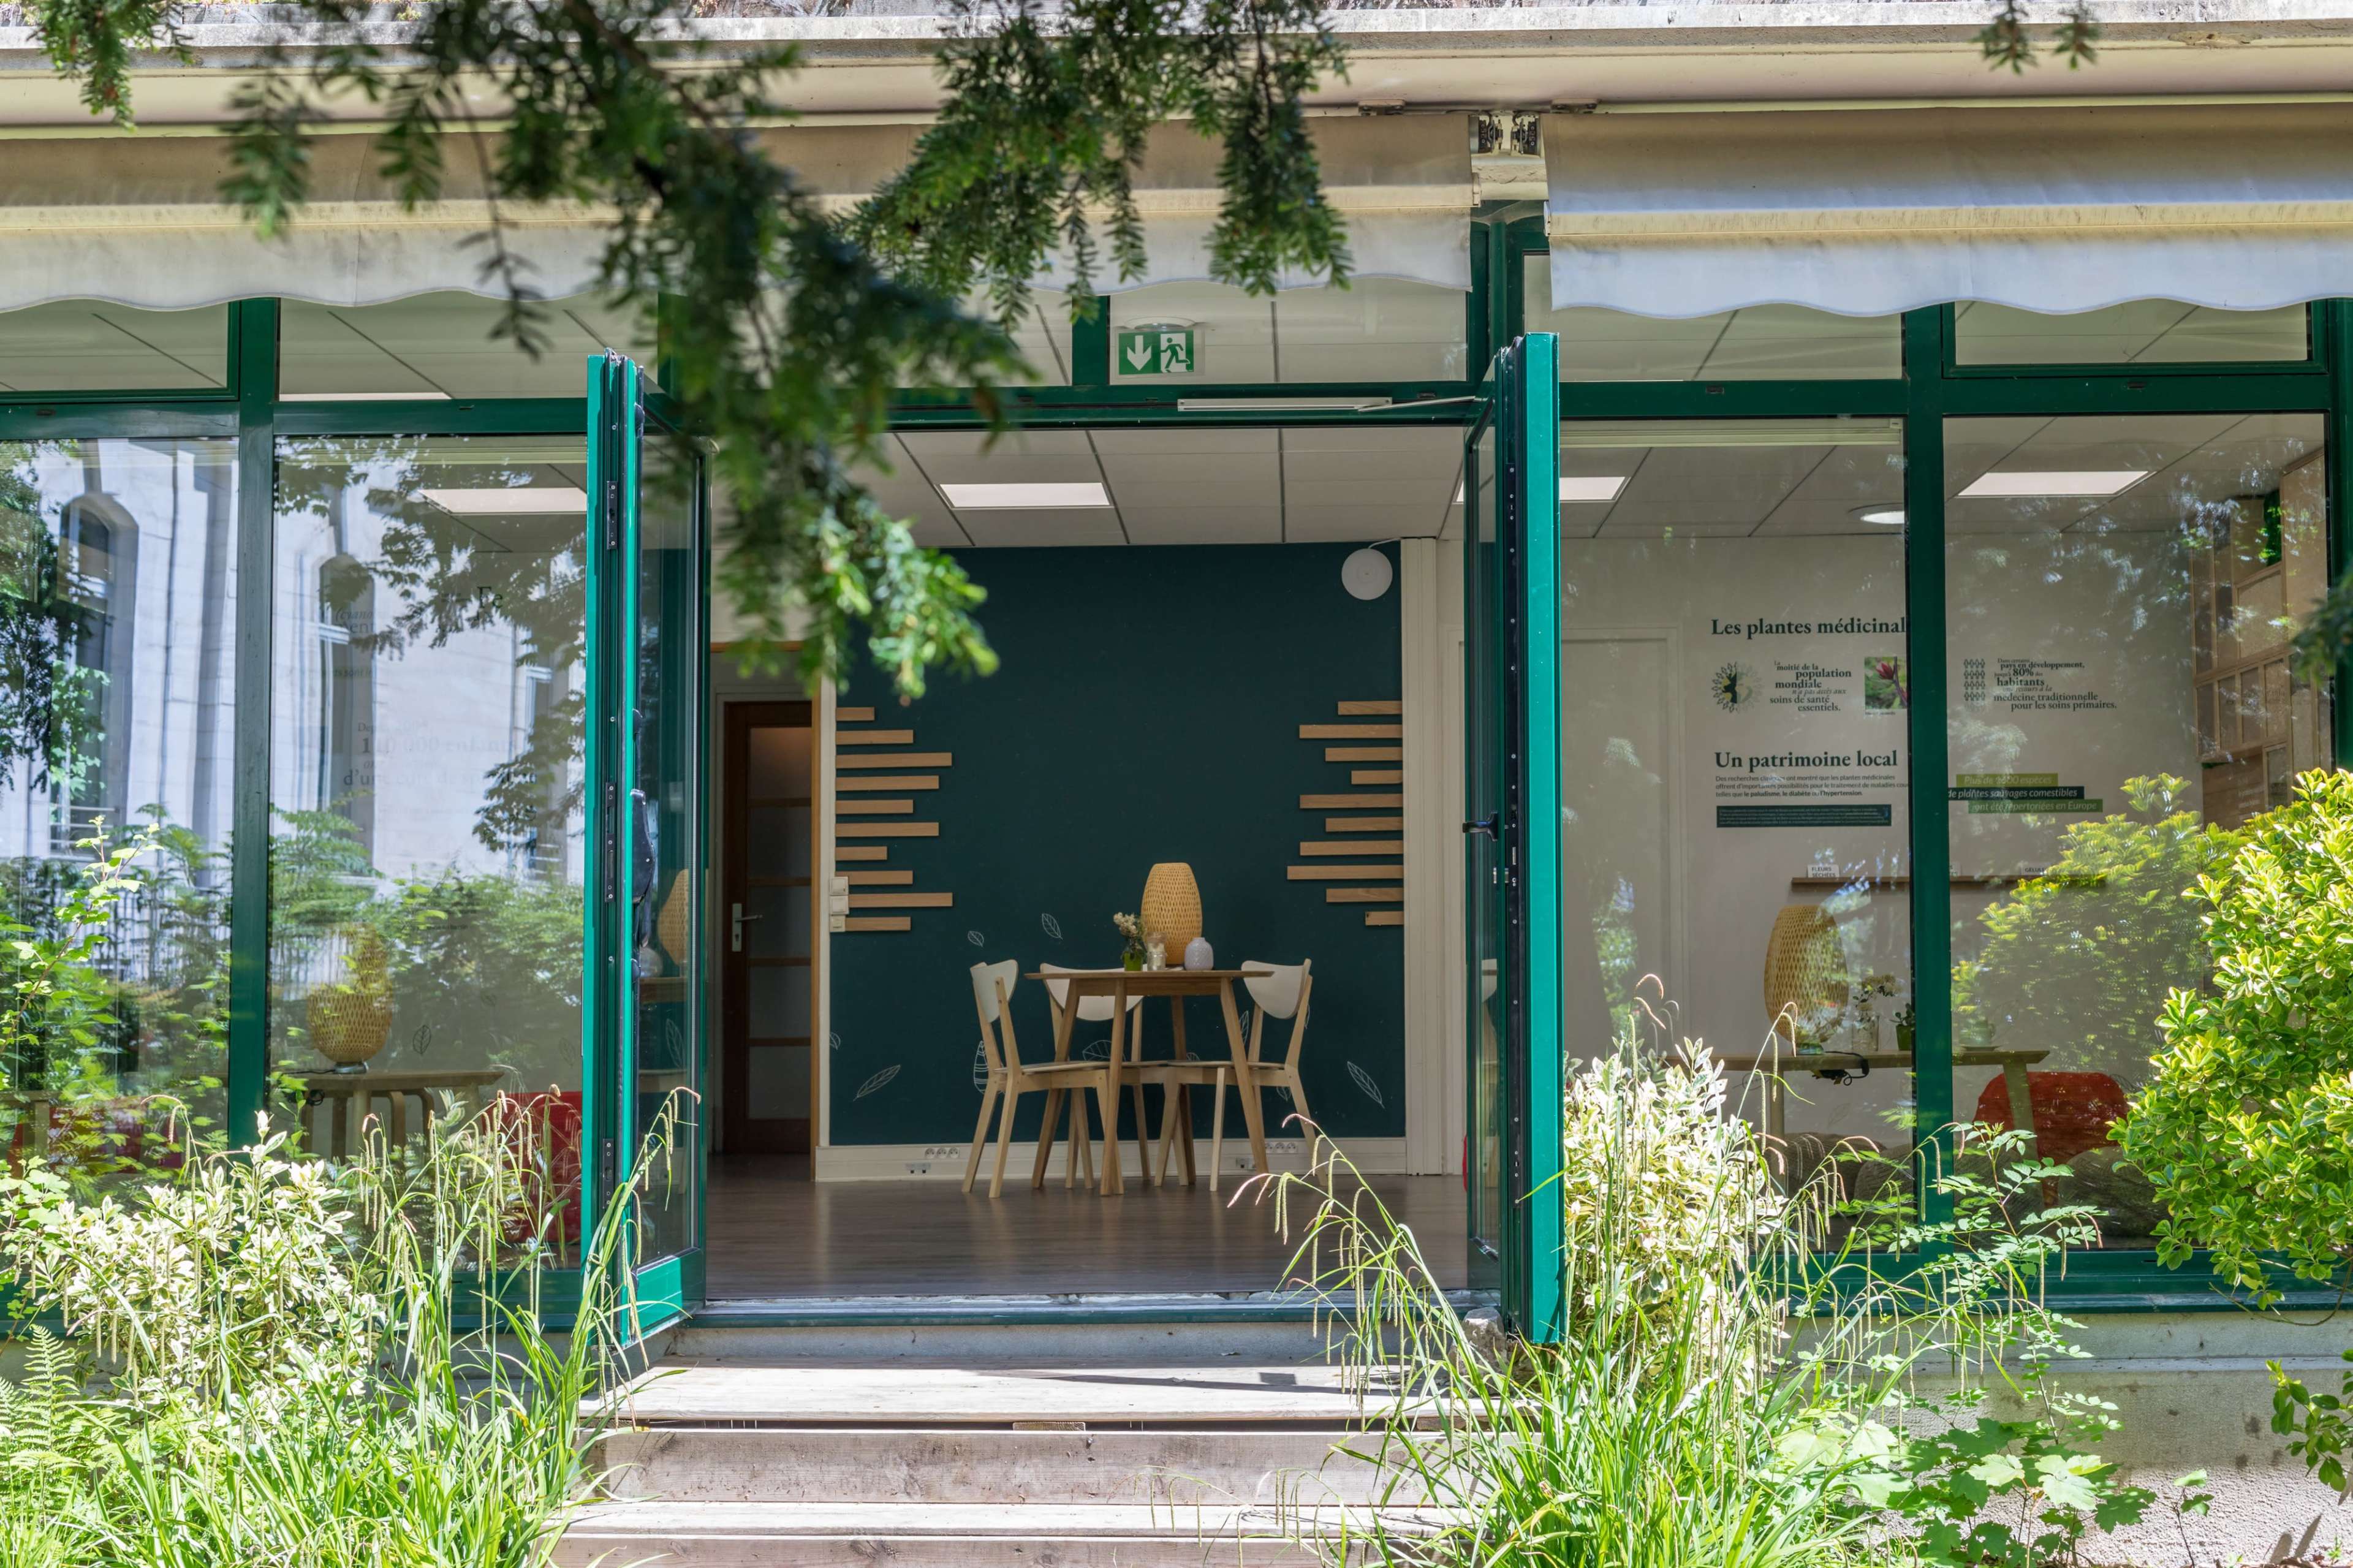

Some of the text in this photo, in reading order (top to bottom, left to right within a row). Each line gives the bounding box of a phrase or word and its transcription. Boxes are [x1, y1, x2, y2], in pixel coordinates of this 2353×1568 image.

[1711, 616, 1906, 639] Les plantes médicinal
[1795, 668, 1851, 681] population
[2013, 668, 2034, 676] 80%
[1775, 680, 1822, 689] mondiale
[1997, 677, 2045, 686] habitants
[2038, 692, 2098, 701] traditionnelle
[1798, 702, 1841, 711] essentiels.
[2011, 702, 2031, 711] pour
[2073, 700, 2116, 711] primaires.
[1715, 750, 1898, 773] Un patrimoine local
[2020, 776, 2052, 785] espèces
[1958, 789, 1988, 799] plantes
[1990, 789, 2027, 799] sauvages
[2029, 788, 2078, 797] comestibles
[2006, 802, 2055, 812] répertoriées
[2068, 801, 2097, 811] Europe
